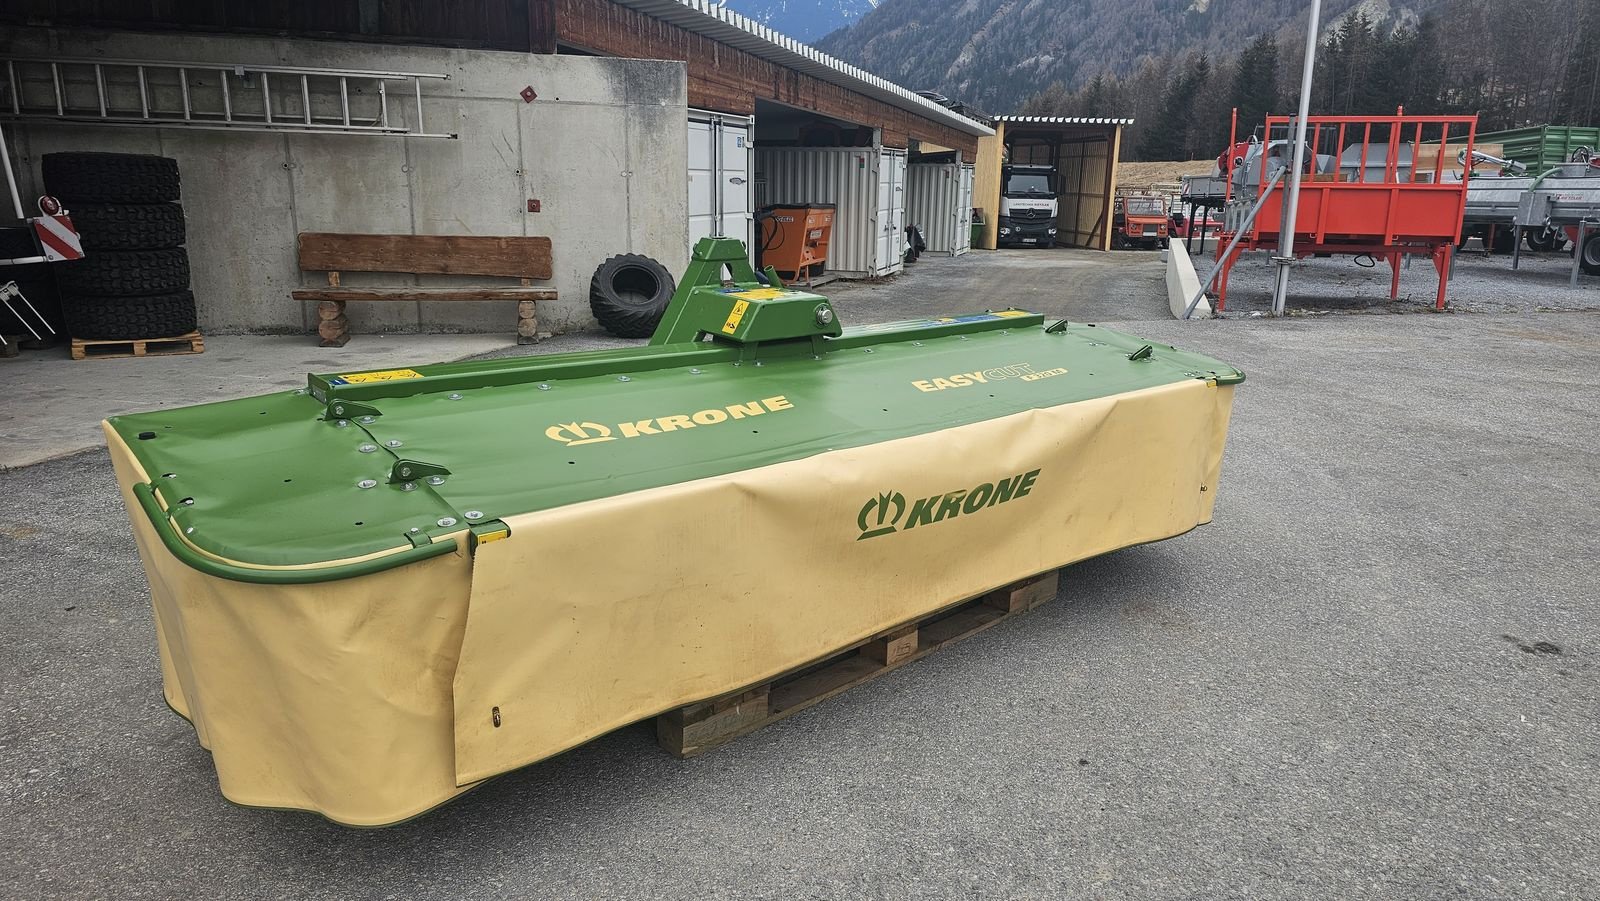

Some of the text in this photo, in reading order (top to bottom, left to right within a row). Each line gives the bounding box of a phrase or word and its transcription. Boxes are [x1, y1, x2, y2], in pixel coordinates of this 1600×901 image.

[911, 362, 1035, 393] EASYCUT
[617, 395, 795, 438] KRONE
[903, 468, 1042, 531] KRONE
